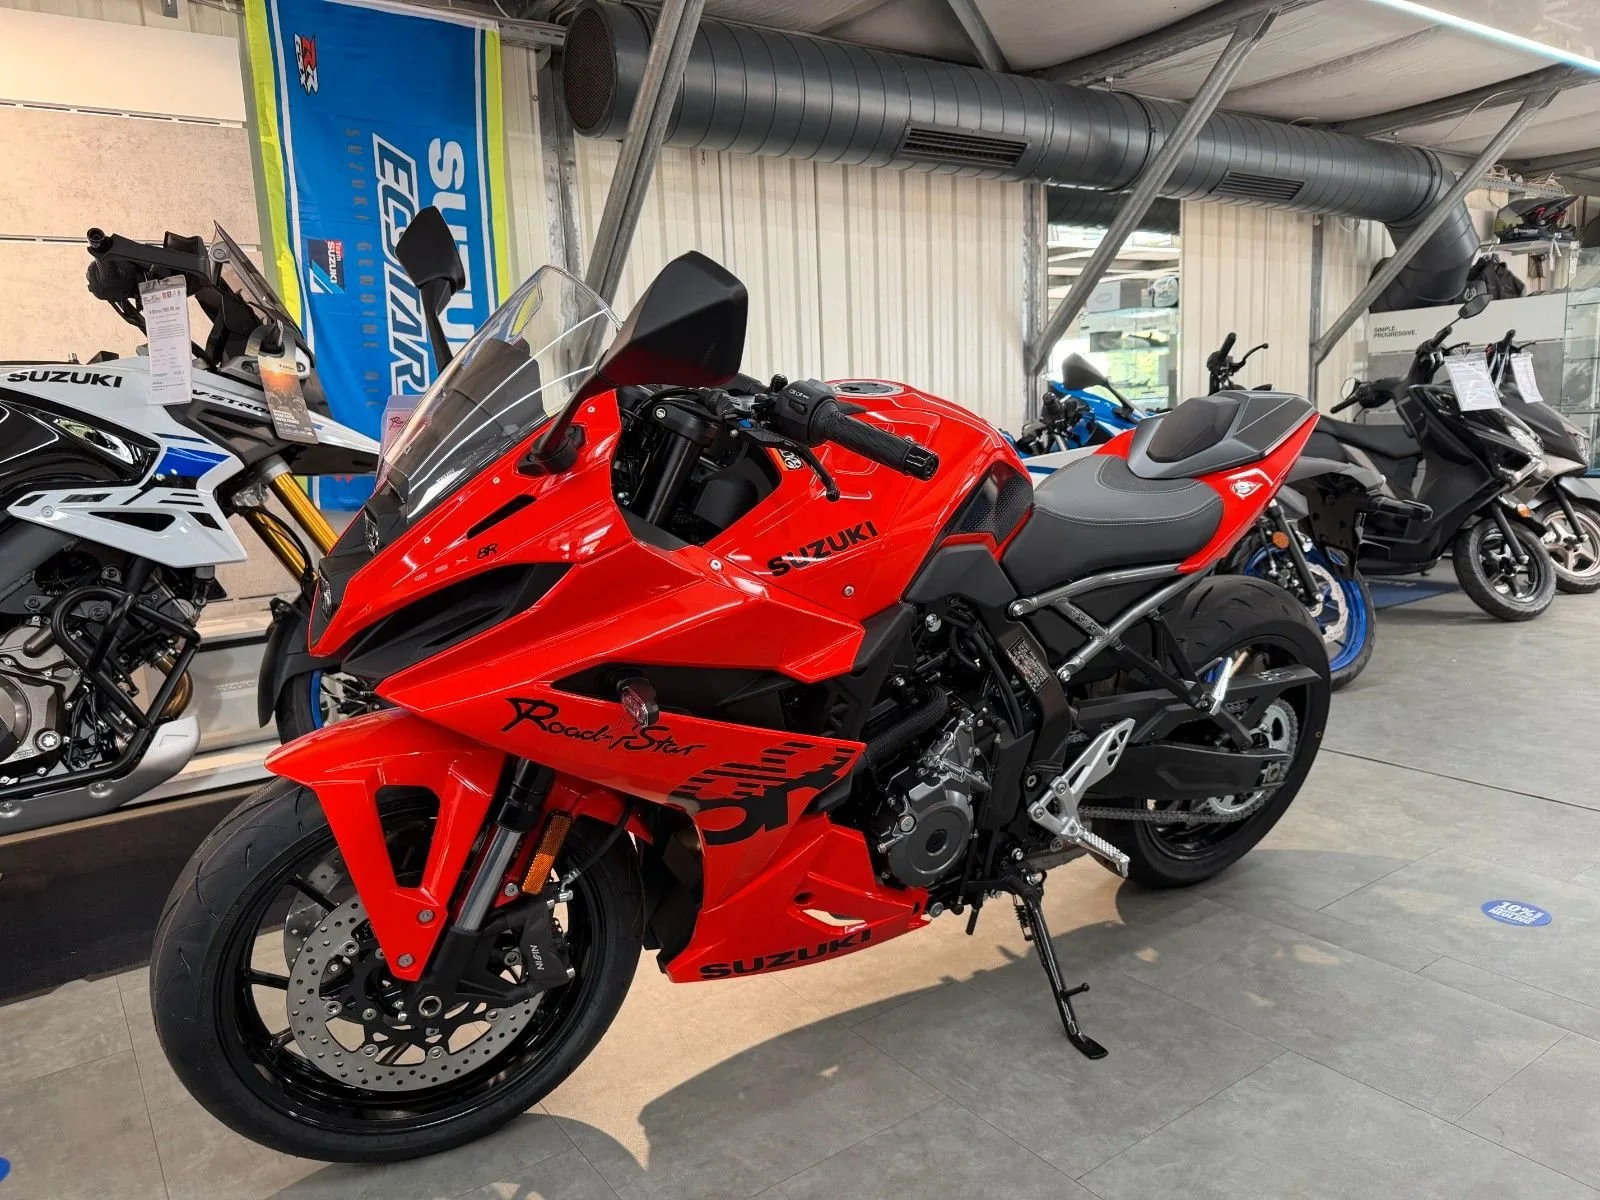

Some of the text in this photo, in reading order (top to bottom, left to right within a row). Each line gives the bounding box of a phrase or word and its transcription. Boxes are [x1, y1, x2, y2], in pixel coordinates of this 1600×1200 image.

[327, 240, 338, 284] SUZUKI
[344, 127, 382, 409] SUZUKI GENUINE OIL
[372, 132, 431, 395] ECTAR
[7, 370, 123, 388] SUZUKI
[192, 389, 271, 415] V-STRO
[767, 520, 879, 577] SUZUKI
[501, 697, 610, 743] Road
[700, 928, 873, 981] SUZUKI
